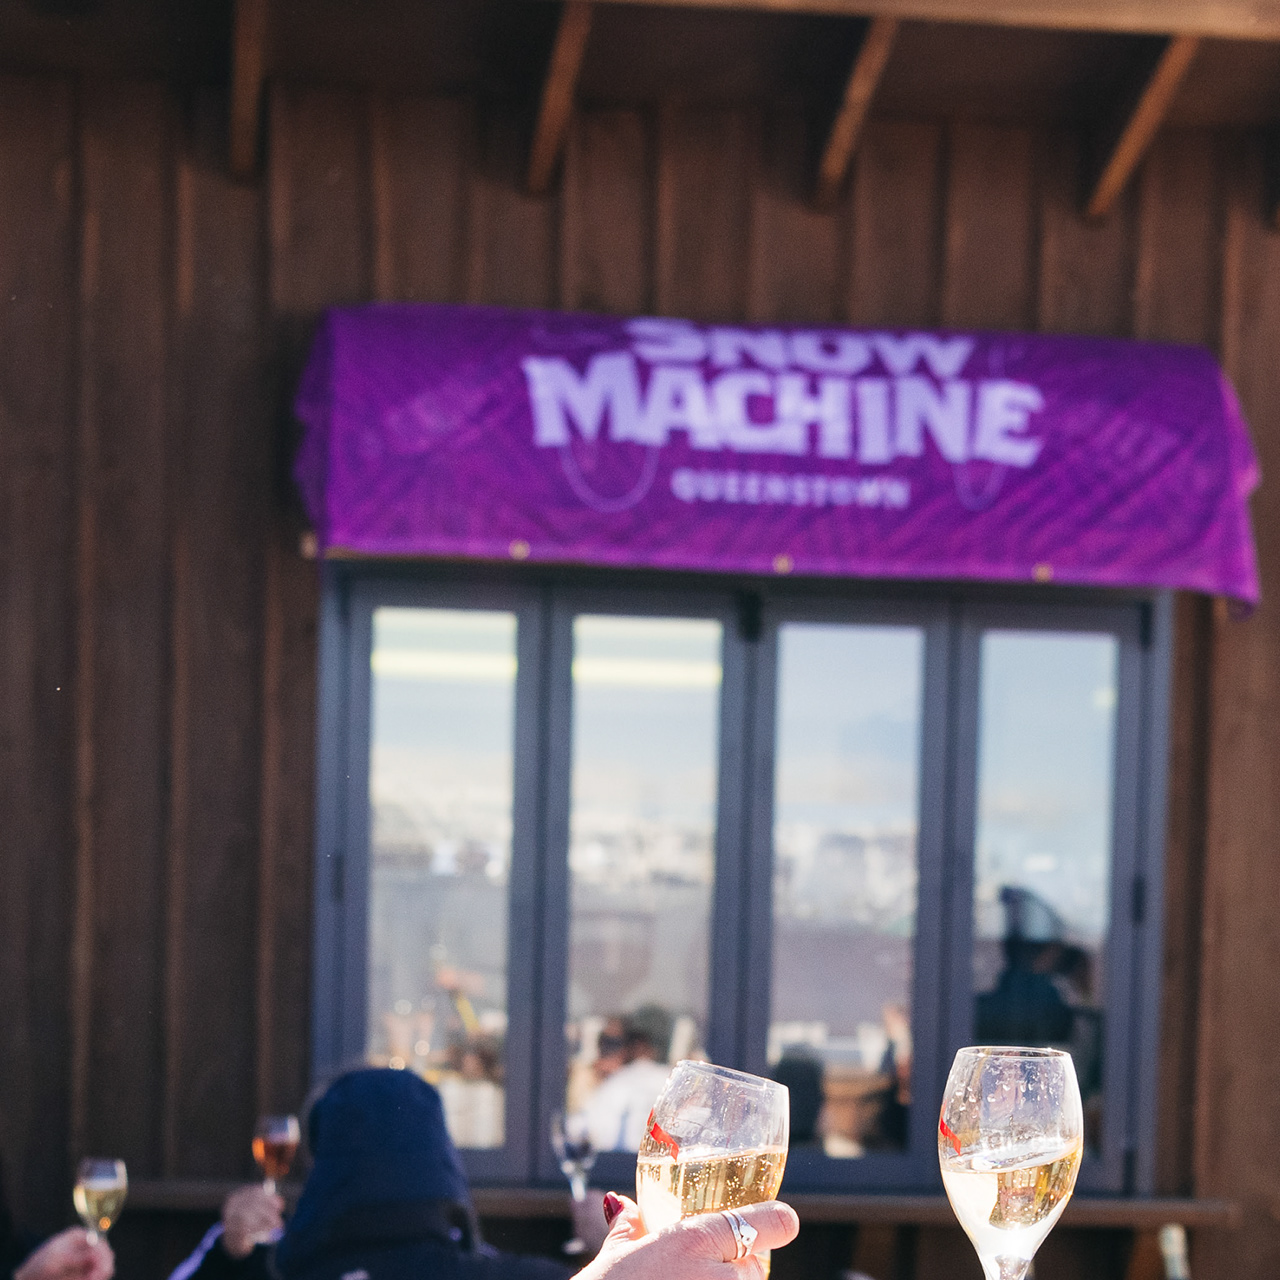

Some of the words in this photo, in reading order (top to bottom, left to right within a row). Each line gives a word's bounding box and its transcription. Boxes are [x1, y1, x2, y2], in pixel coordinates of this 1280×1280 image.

[625, 317, 975, 379] SNOW
[522, 350, 1044, 468] MACHINE
[670, 466, 910, 511] QUEENSTOWN
